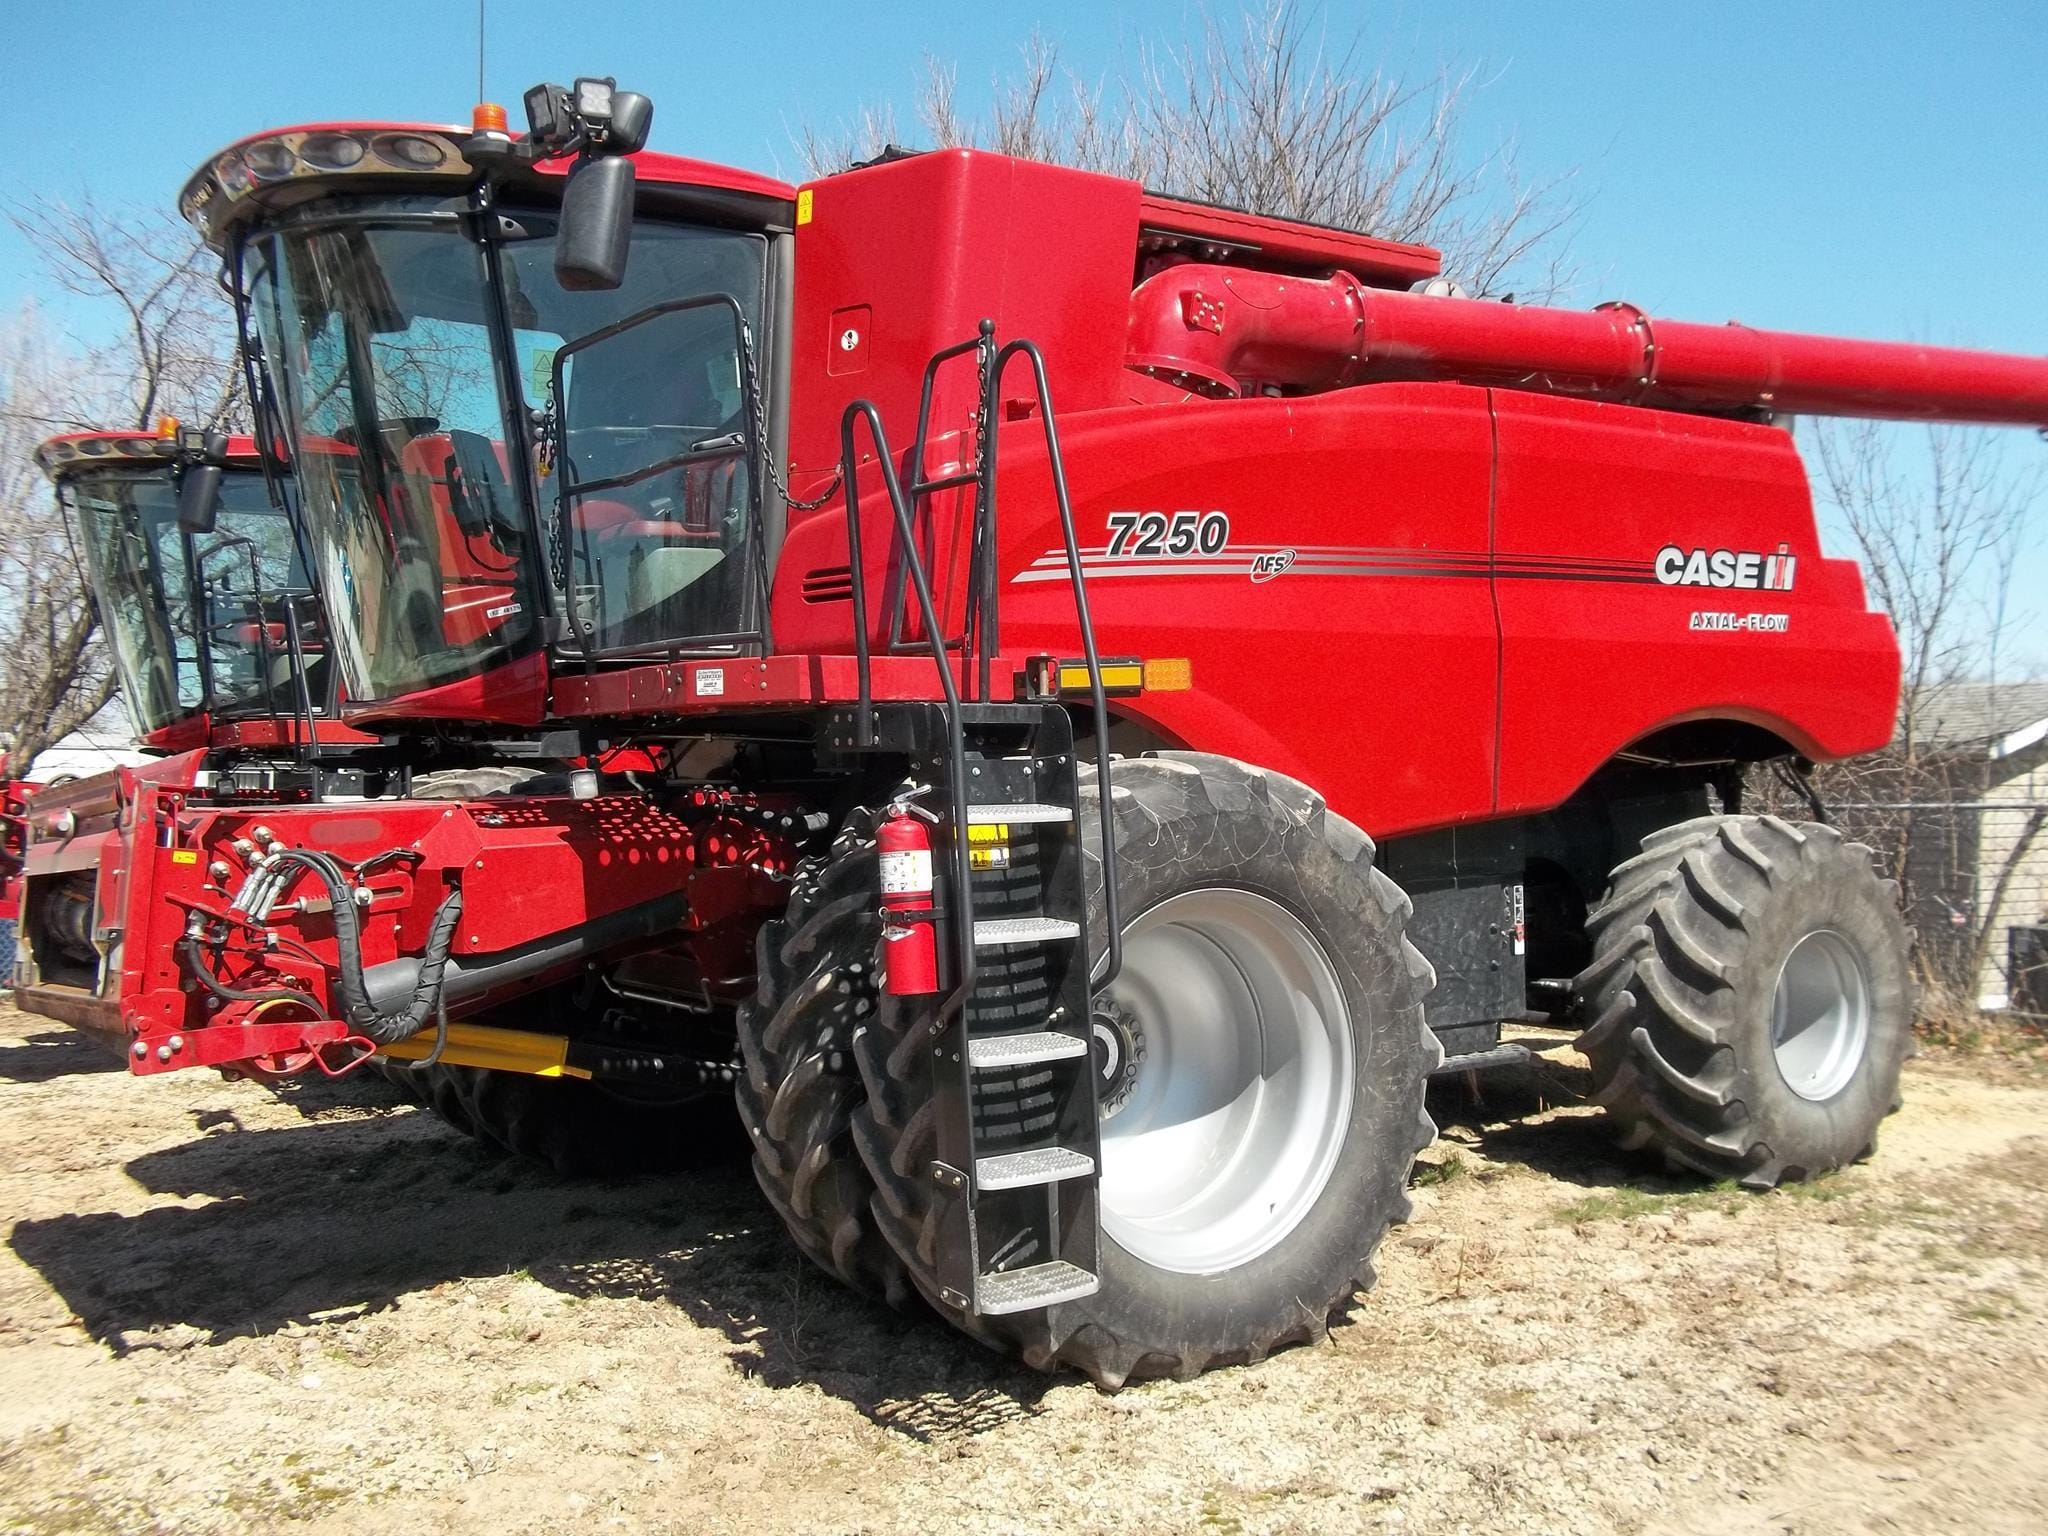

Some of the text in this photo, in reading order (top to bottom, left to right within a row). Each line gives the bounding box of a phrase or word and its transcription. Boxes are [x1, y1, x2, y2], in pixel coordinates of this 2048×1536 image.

[1107, 511, 1229, 558] 7250
[1251, 554, 1287, 575] AFS
[1655, 546, 1761, 588] CASE
[1689, 612, 1788, 632] AXIAL-FLOW
